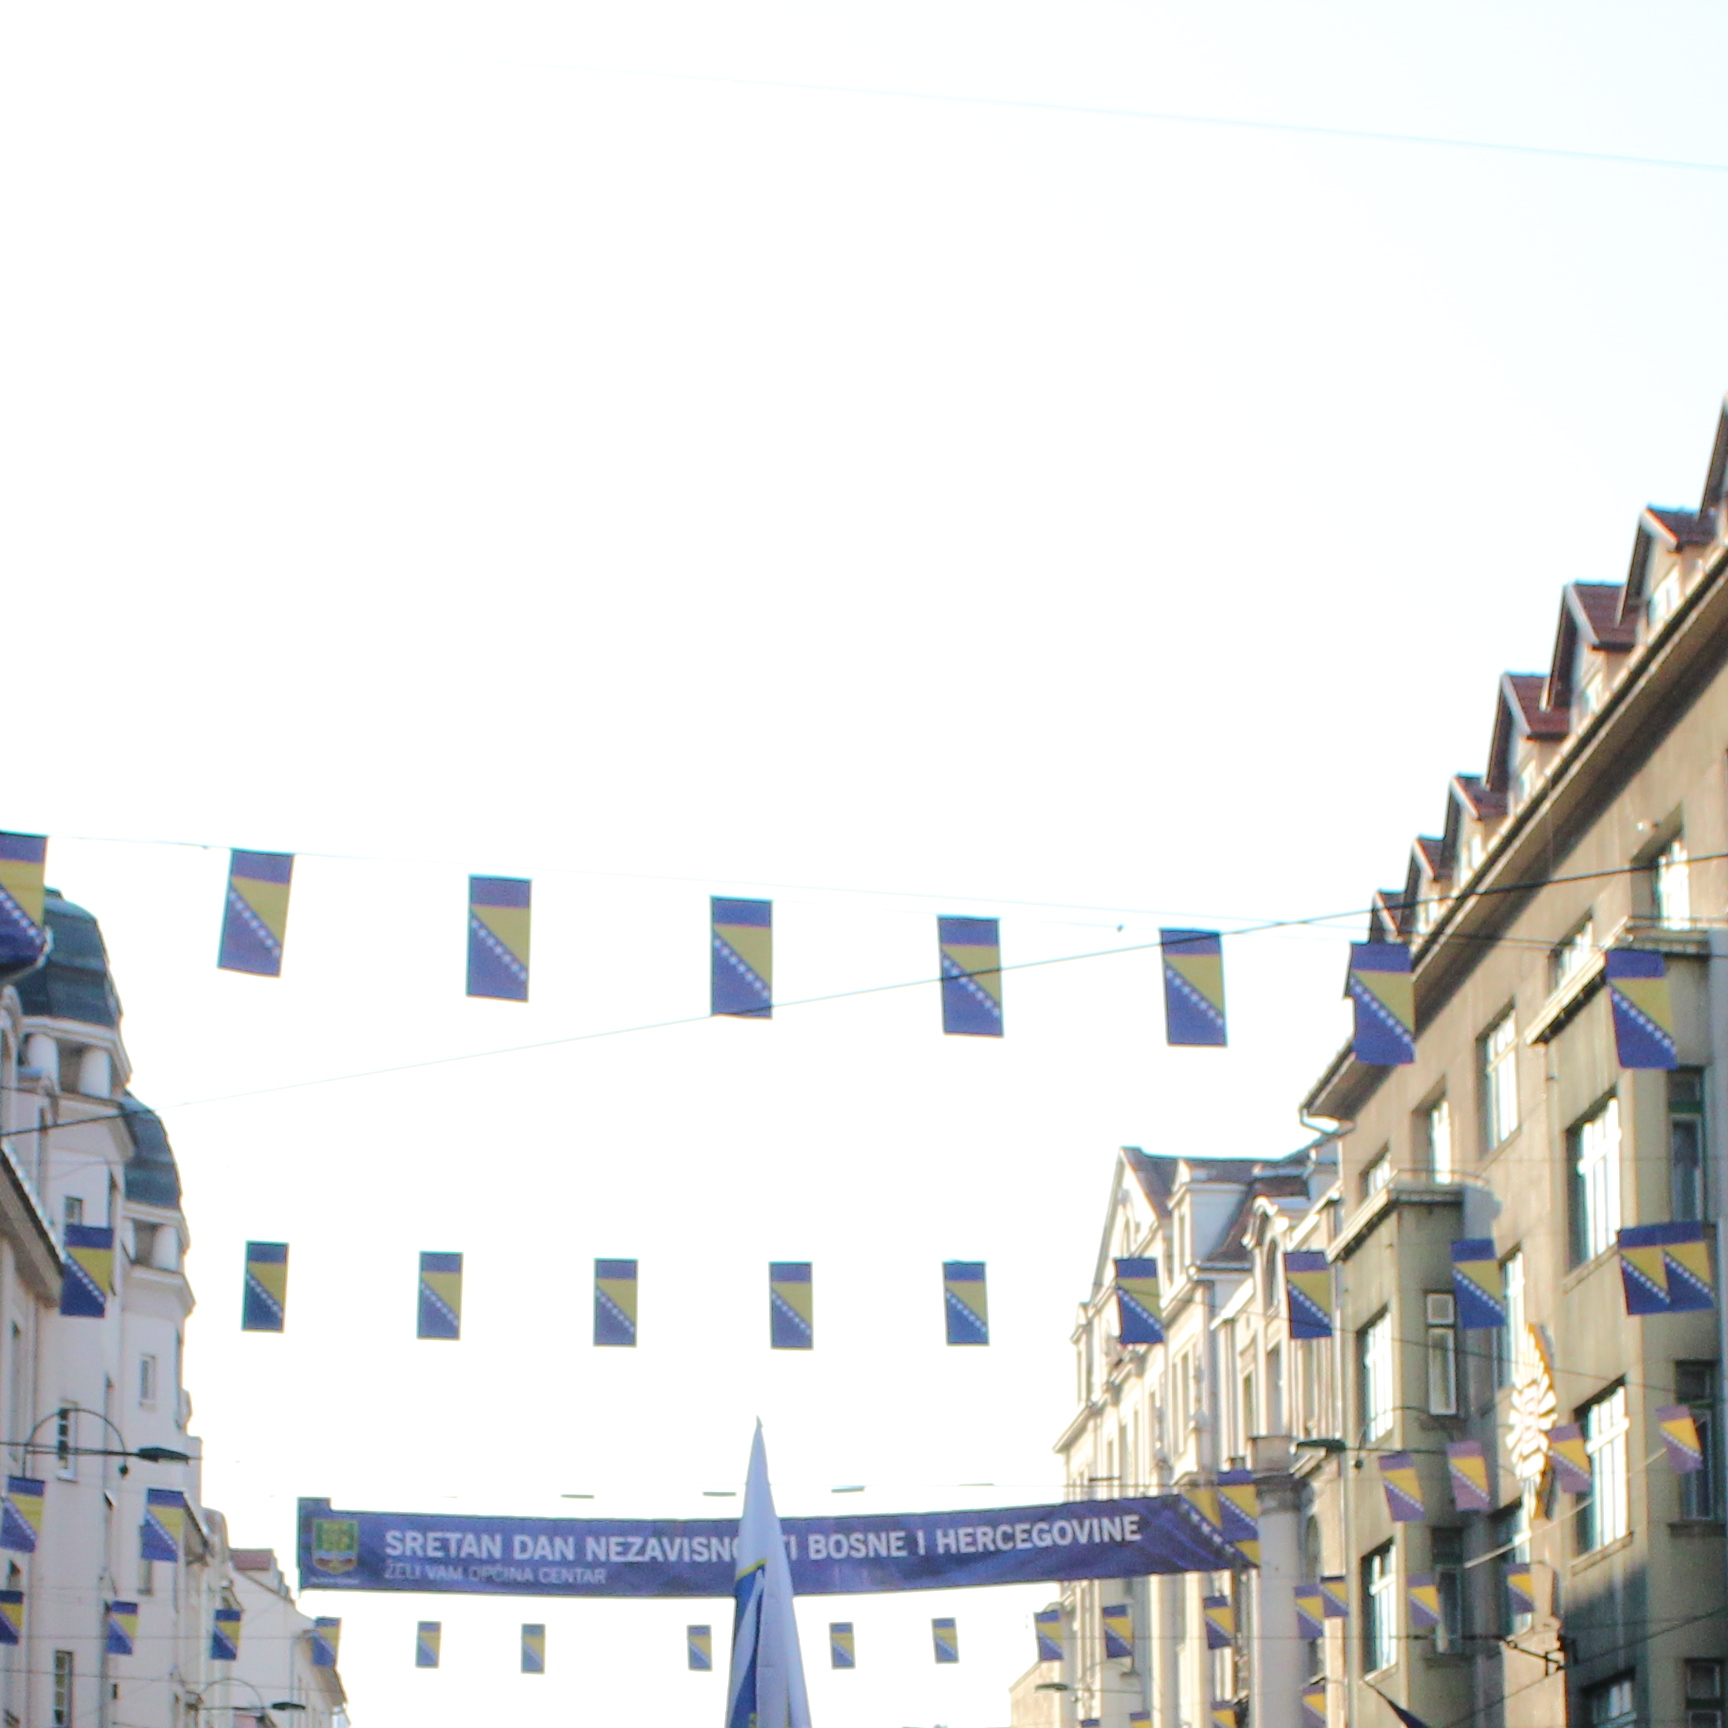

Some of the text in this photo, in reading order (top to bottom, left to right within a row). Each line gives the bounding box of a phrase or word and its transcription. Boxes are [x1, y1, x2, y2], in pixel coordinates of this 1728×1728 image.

[384, 1513, 1143, 1563] SRETAN DAN NEZAVISNI BOSNE I HERCEGOVINE
[425, 1564, 462, 1581] VAM
[538, 1567, 607, 1585] CENTAR
